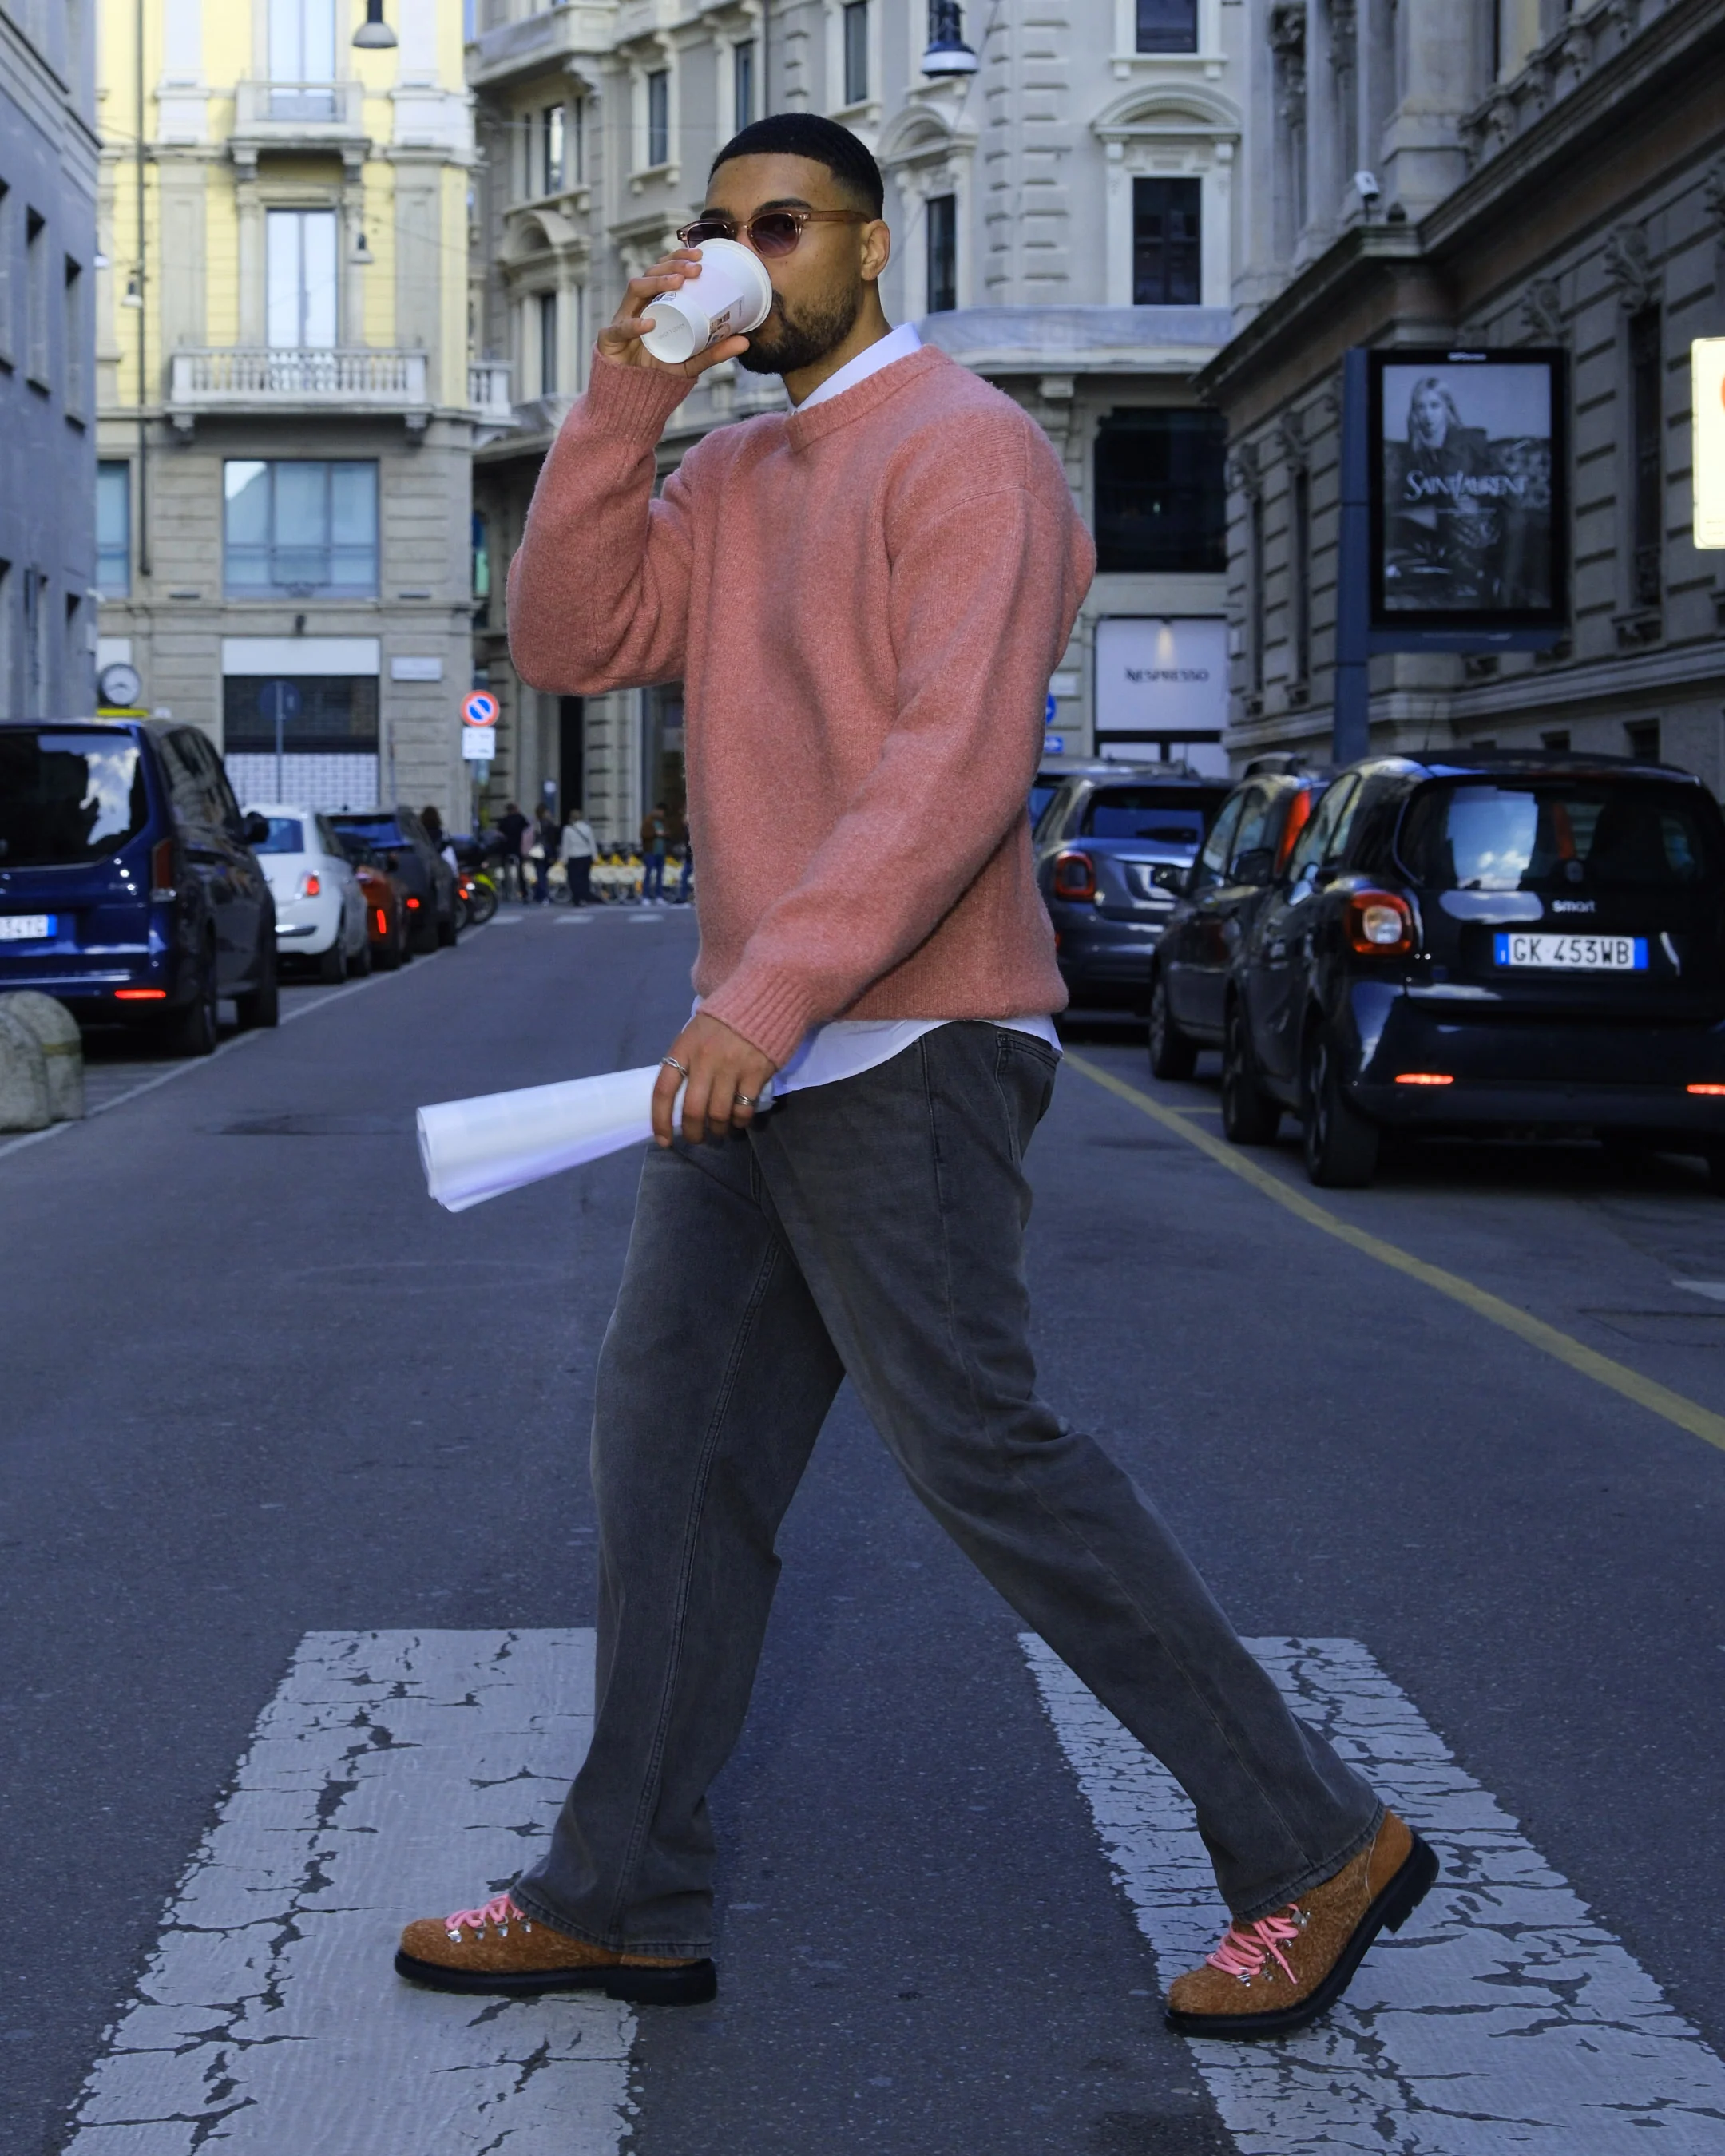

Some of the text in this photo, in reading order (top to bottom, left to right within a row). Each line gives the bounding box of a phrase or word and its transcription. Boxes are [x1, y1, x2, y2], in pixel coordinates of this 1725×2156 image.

[1124, 668, 1209, 684] NESPRESSO
[1552, 900, 1596, 912] smart
[1513, 938, 1542, 962] GK
